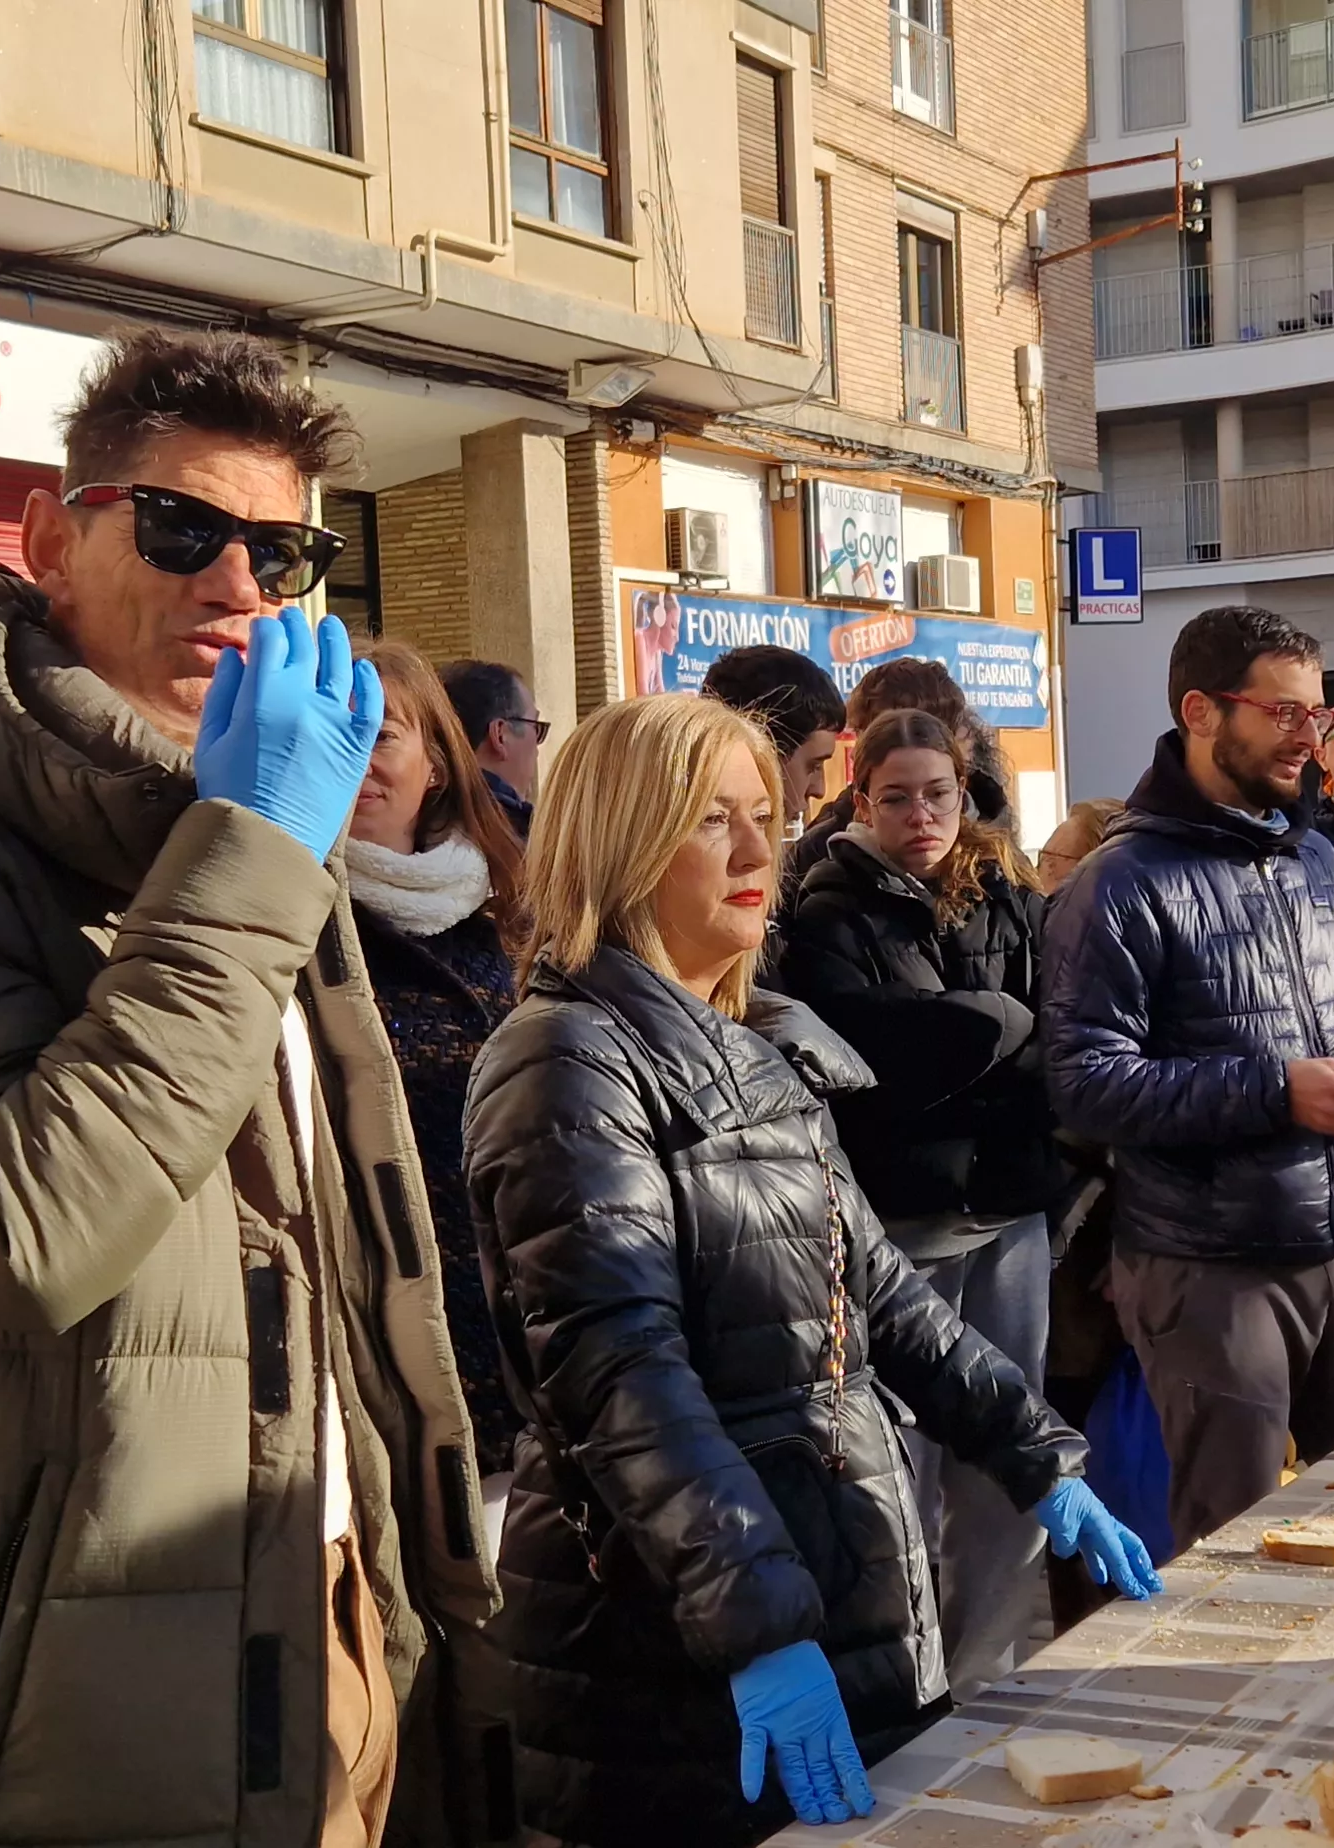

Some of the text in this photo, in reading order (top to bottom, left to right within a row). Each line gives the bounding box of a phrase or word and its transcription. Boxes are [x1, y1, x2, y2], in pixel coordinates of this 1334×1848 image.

[823, 487, 897, 517] AUTOESCUELA
[841, 517, 898, 569] Goya
[1091, 537, 1125, 590] L
[1079, 602, 1140, 615] PRACTICAS
[686, 607, 810, 651] FORMACIÓN
[840, 614, 909, 657] OFERTÓN
[677, 652, 689, 671] 24
[957, 641, 1031, 660] NUESTRA EXPERIENCIA
[959, 661, 975, 685] TU
[976, 660, 1032, 688] GARANTÍA
[964, 689, 1033, 708] UE NO TE ENGAÑEN
